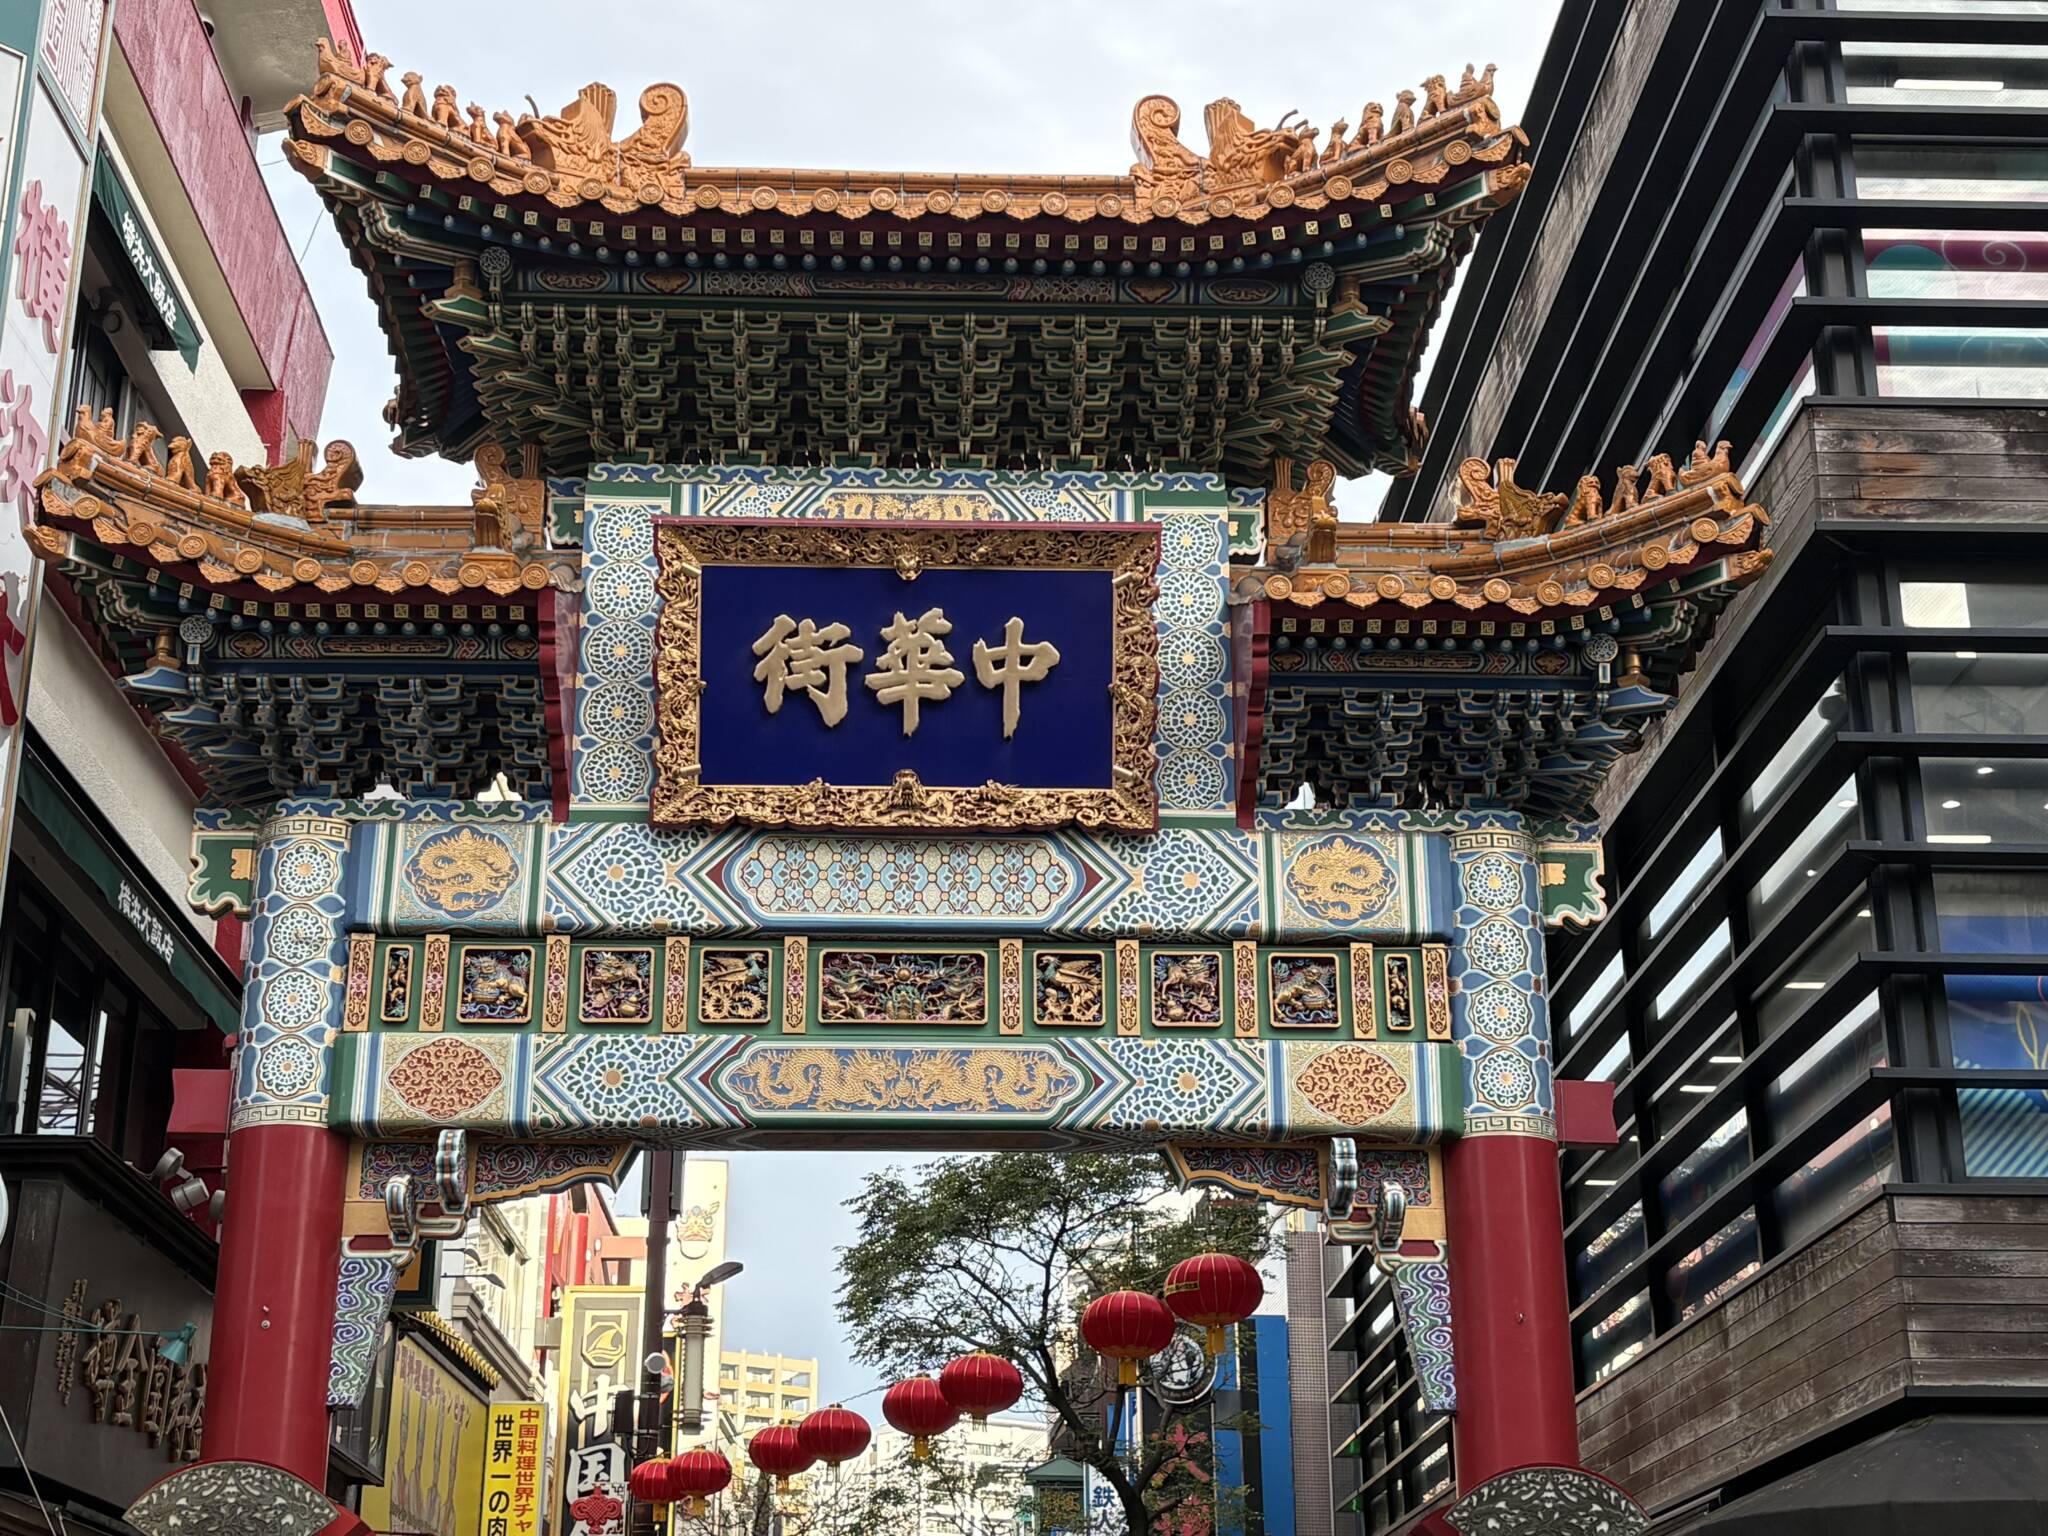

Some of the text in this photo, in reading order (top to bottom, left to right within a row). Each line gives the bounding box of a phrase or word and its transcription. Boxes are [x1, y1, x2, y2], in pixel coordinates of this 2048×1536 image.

[117, 879, 175, 965] 横浜大飯店
[487, 1414, 514, 1536] 世界一の肉
[565, 1373, 634, 1536] 中国
